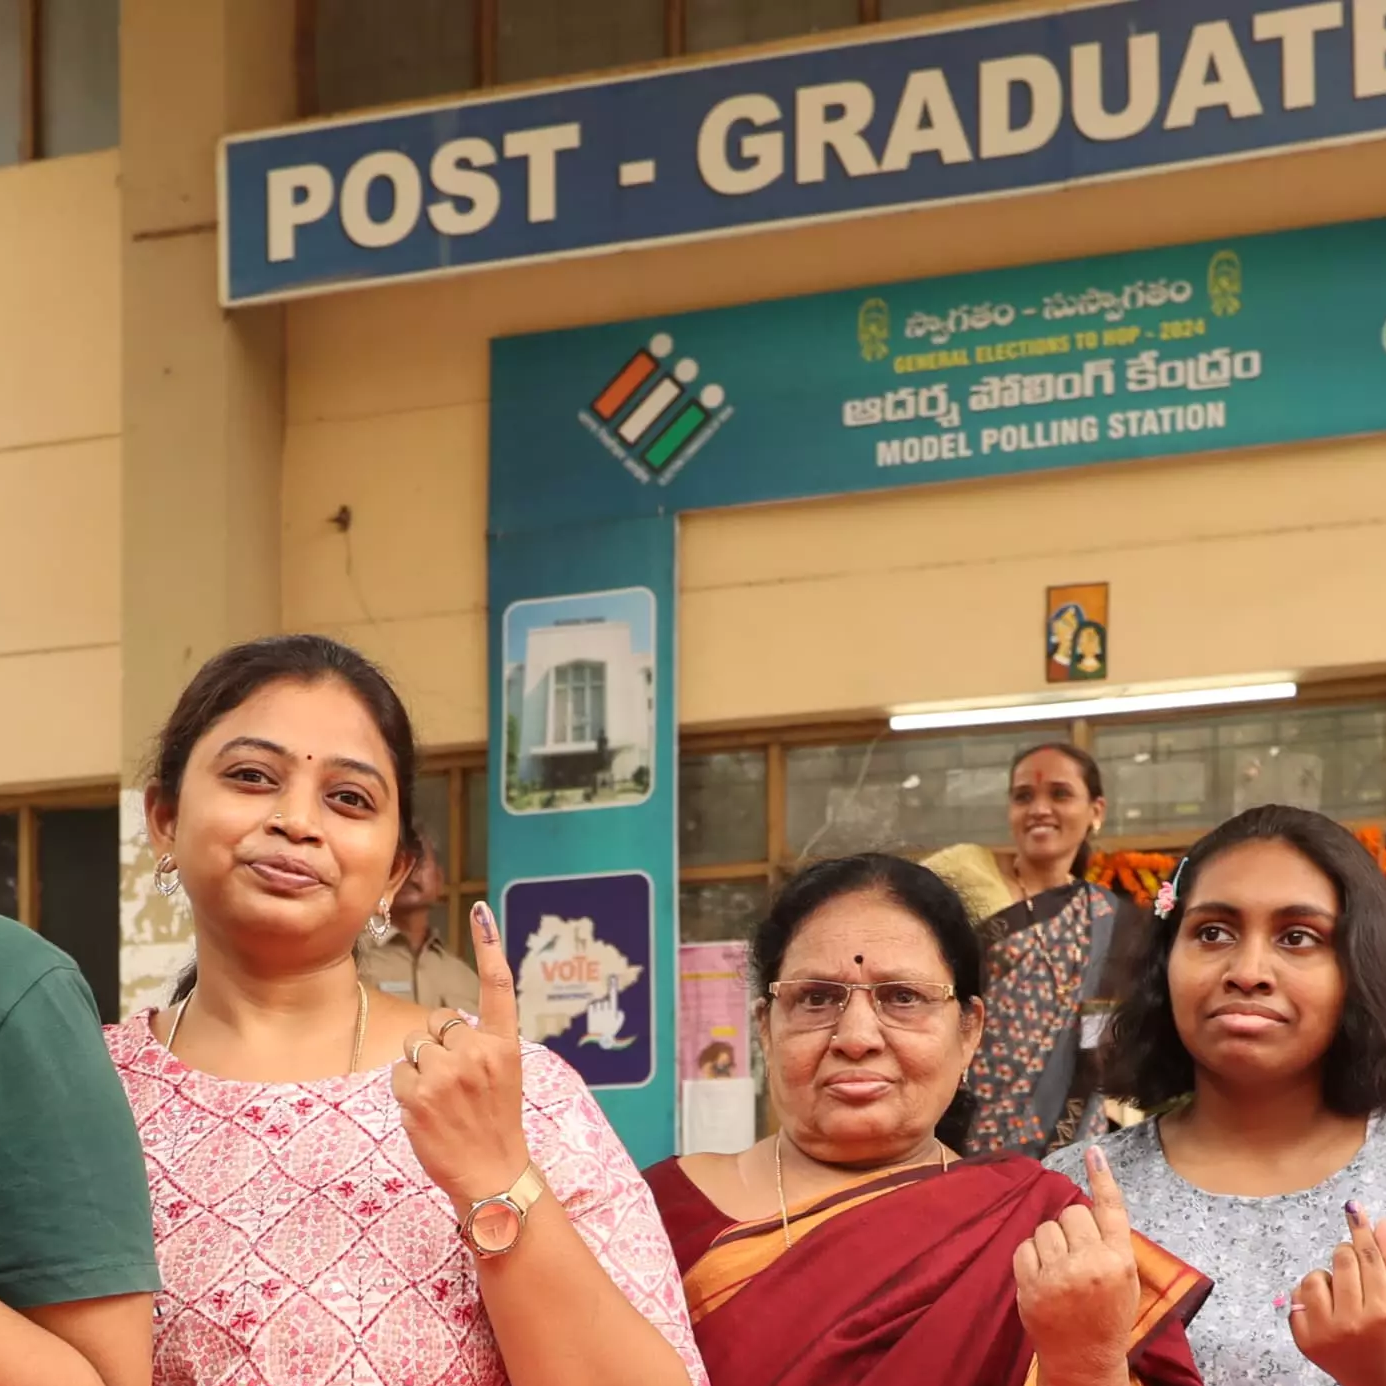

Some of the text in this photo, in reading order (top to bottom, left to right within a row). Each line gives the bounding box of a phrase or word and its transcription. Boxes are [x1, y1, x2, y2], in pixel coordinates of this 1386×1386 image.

[266, 122, 582, 263] POST
[618, 159, 656, 187] -
[893, 349, 971, 373] GENERAL
[975, 334, 1071, 364] ELECTIONS
[1075, 331, 1099, 350] TO
[1159, 319, 1205, 341] 2024
[904, 301, 1015, 345] స్వాగతం
[842, 347, 1262, 428] ఆదర్శ పోలింగ్ కేంద్రం
[875, 401, 1227, 467] MODEL POLLING STATION
[540, 955, 601, 983] VOTE
